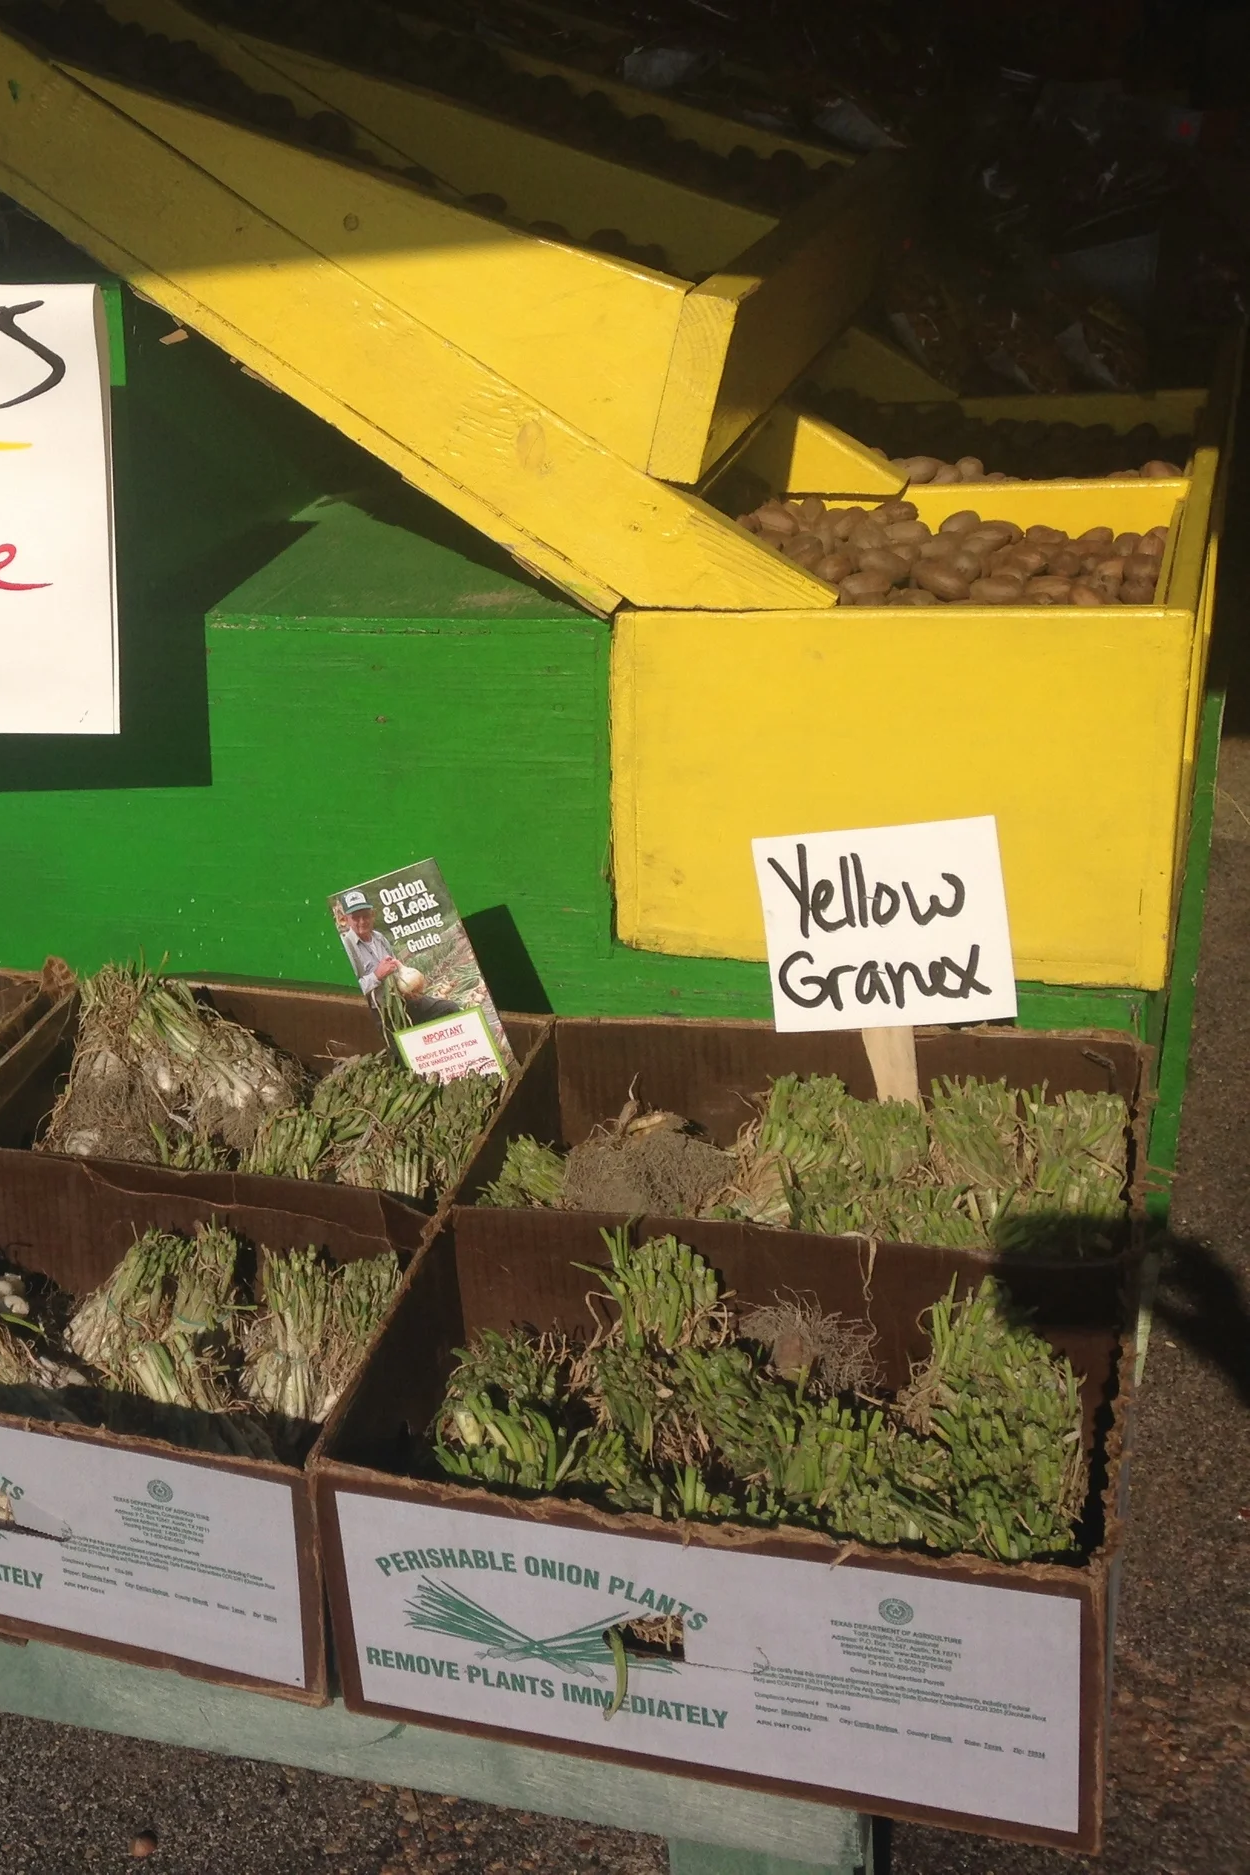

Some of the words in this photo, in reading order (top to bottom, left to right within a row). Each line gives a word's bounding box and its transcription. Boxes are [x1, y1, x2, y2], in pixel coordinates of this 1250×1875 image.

[379, 879, 428, 906] Onion
[767, 843, 965, 939] Yellow
[383, 907, 399, 924] &
[396, 892, 440, 919] Leek
[390, 912, 444, 940] Planting
[406, 932, 442, 953] Guide
[778, 944, 992, 1011] Granex
[422, 1024, 465, 1044] IMPORTANT
[415, 1050, 439, 1063] REMOVE
[438, 1044, 462, 1057] PLANTS
[461, 1039, 479, 1048] FROM
[418, 1062, 430, 1070] BOX
[431, 1050, 467, 1066] IMMEDIATELY
[375, 1548, 517, 1577] PERISHABLE
[524, 1556, 600, 1590] ONION
[608, 1575, 709, 1631] PLANTS
[830, 1620, 852, 1628] TEXAS
[854, 1623, 900, 1636] DEPARTMENT
[913, 1632, 962, 1645] AGRICULTURE
[366, 1646, 461, 1681] REMOVE
[467, 1664, 555, 1699] PLANTS
[562, 1682, 728, 1729] IMMEDIATELY
